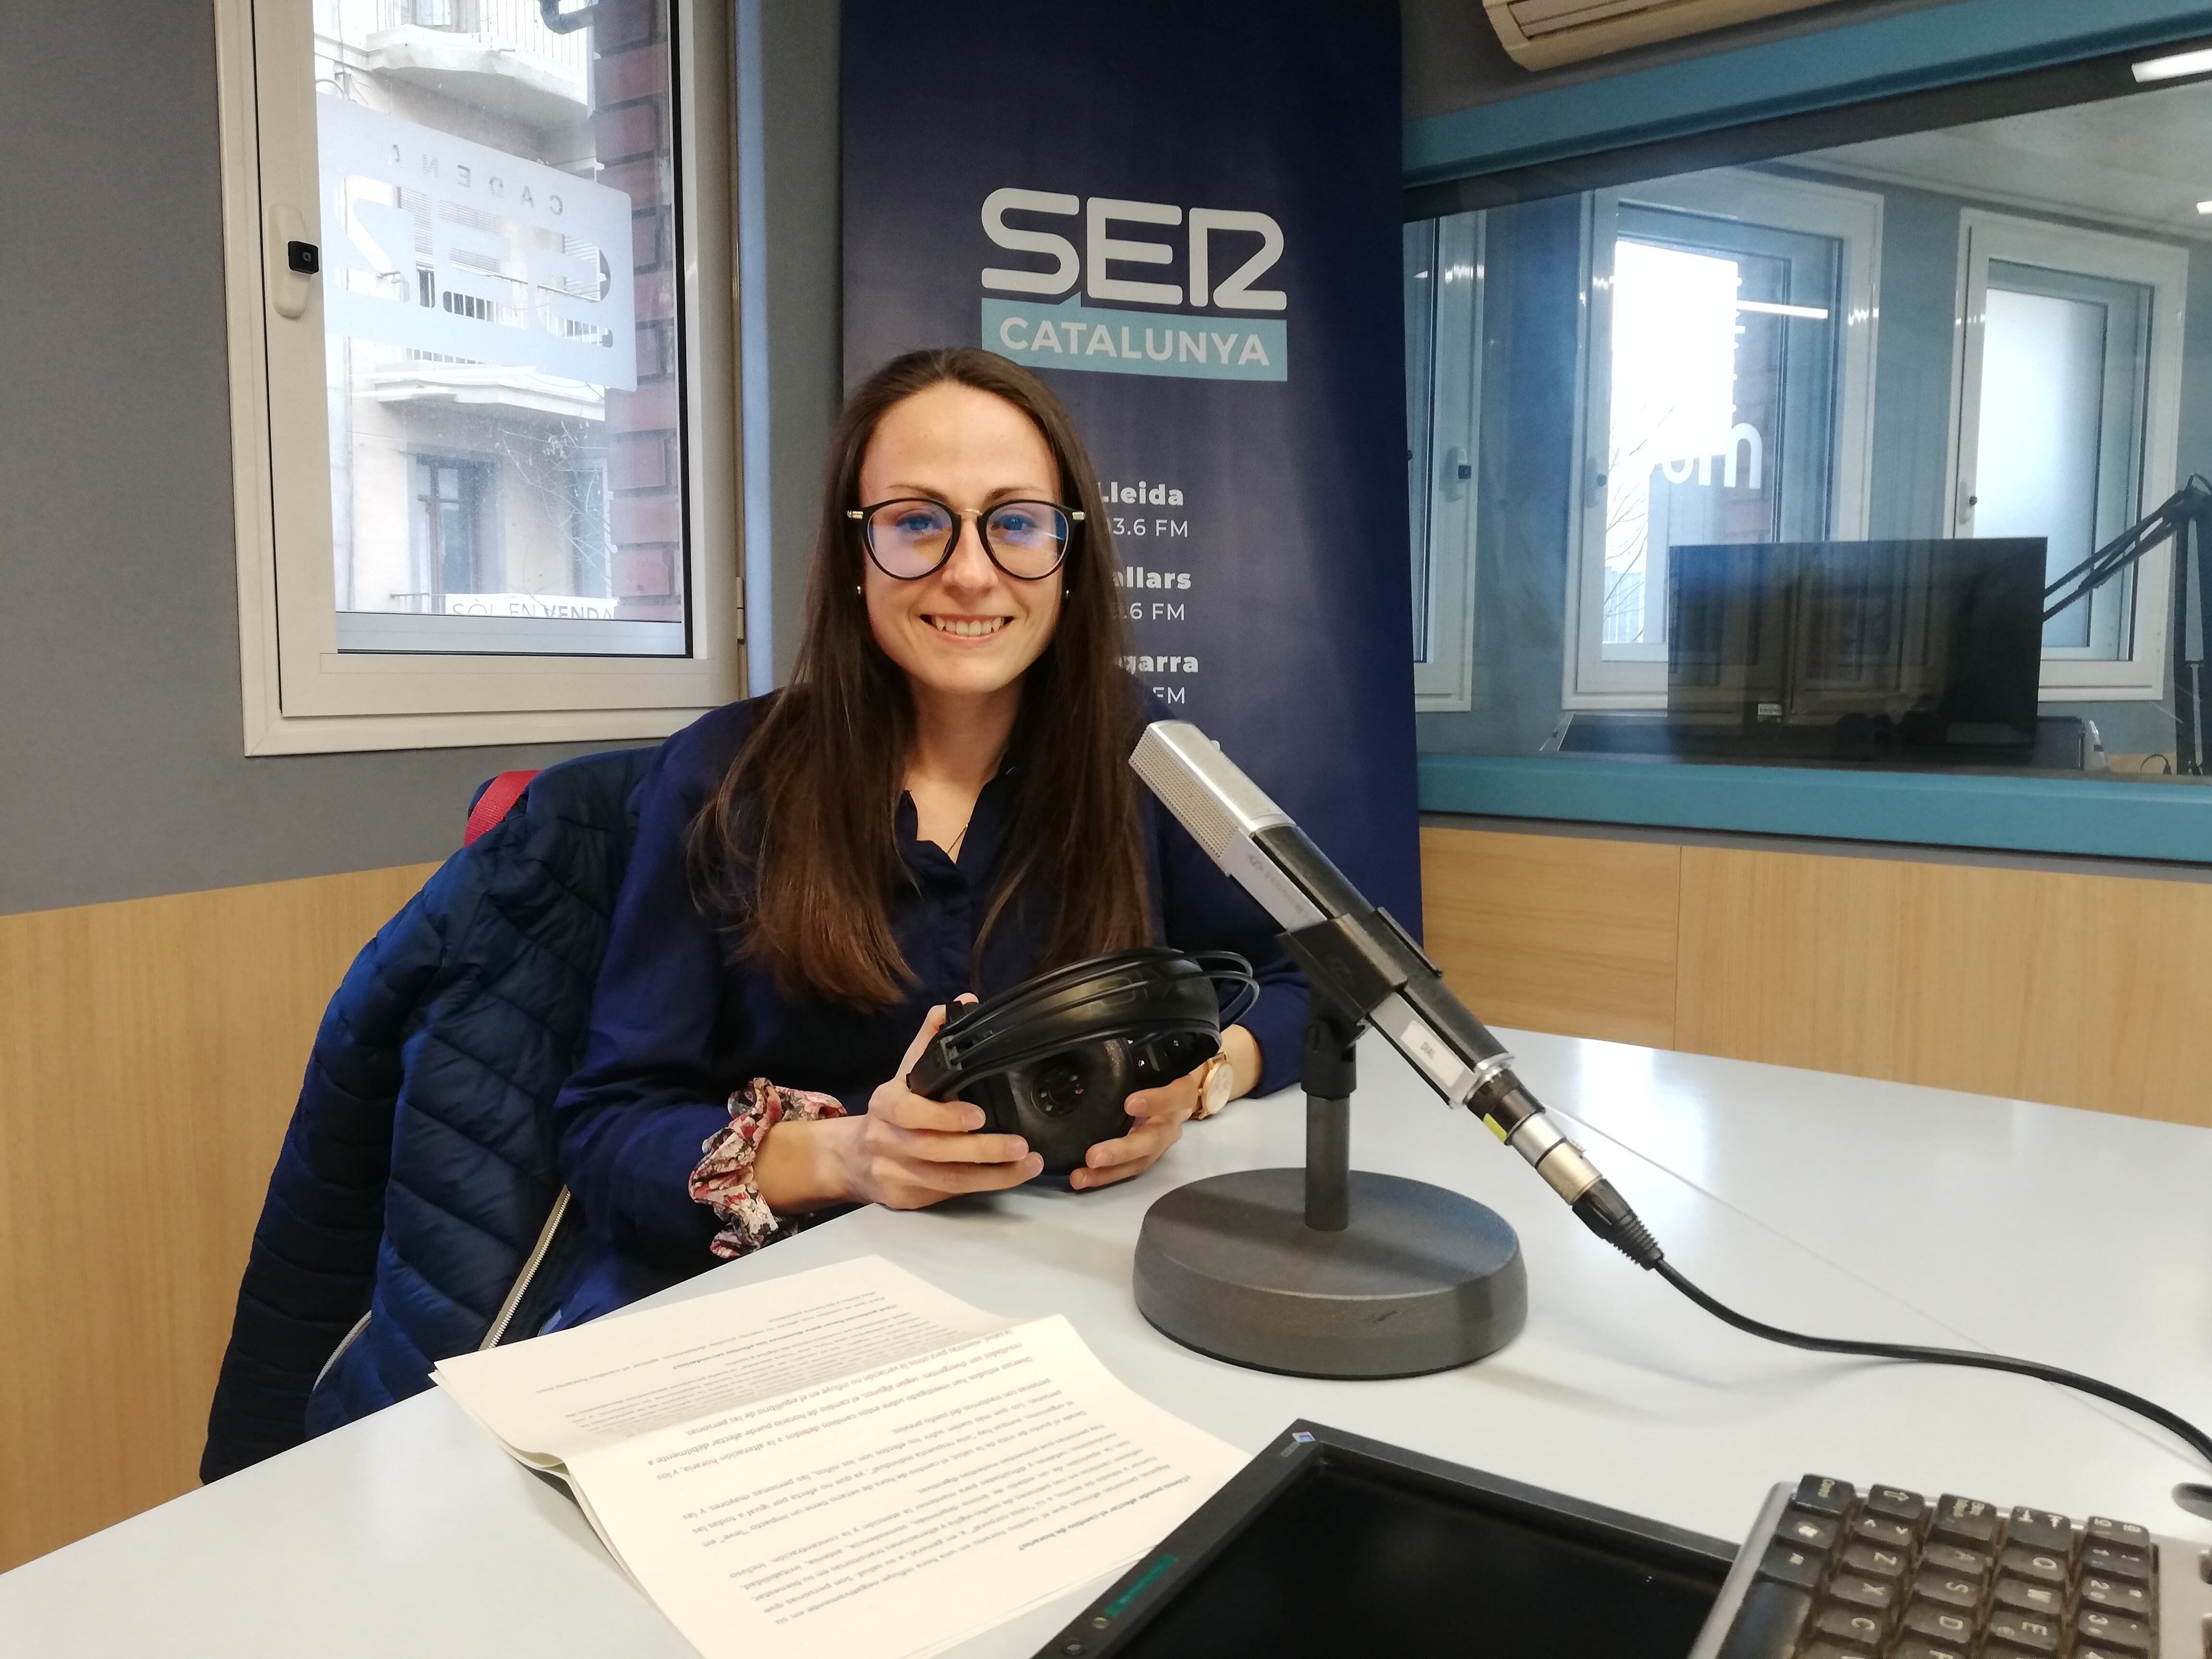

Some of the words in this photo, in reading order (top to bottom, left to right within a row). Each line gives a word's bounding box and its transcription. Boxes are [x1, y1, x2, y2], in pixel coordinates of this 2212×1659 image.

[981, 187, 1287, 311] SER
[999, 317, 1270, 366] CATALUNYA
[1113, 517, 1146, 536] 3.6
[1155, 519, 1188, 538] FM
[1153, 603, 1185, 621] FM
[1153, 686, 1186, 704] FM
[756, 1397, 798, 1415] equilibrio
[728, 1414, 745, 1424] las
[743, 1410, 757, 1419] de
[773, 1413, 807, 1427] horario
[744, 1421, 773, 1436] puede
[784, 1425, 820, 1440] debidos
[711, 1432, 743, 1446] afectar
[656, 1442, 709, 1463] débilmente
[719, 1443, 764, 1461] alteración
[655, 1471, 673, 1481] los
[751, 1478, 794, 1496] personas
[708, 1494, 750, 1511] mayores
[771, 1495, 790, 1507] por
[681, 1511, 699, 1521] las
[745, 1503, 770, 1517] igual
[789, 1508, 804, 1517] un
[707, 1515, 737, 1528] todas
[749, 1514, 790, 1531] impacto
[691, 1525, 709, 1535] las
[720, 1529, 750, 1543] “leve”
[701, 1538, 717, 1548] en
[1874, 1551, 1898, 1566] Z
[728, 1562, 767, 1578] Incluso
[785, 1582, 832, 1604] personas
[1863, 1582, 1886, 1596] X
[1945, 1581, 1969, 1593] S
[762, 1602, 785, 1614] que
[789, 1609, 805, 1619] en
[773, 1616, 789, 1625] su
[1851, 1617, 1875, 1631] C
[1938, 1615, 1963, 1631] D
[2021, 1621, 2048, 1636] E
